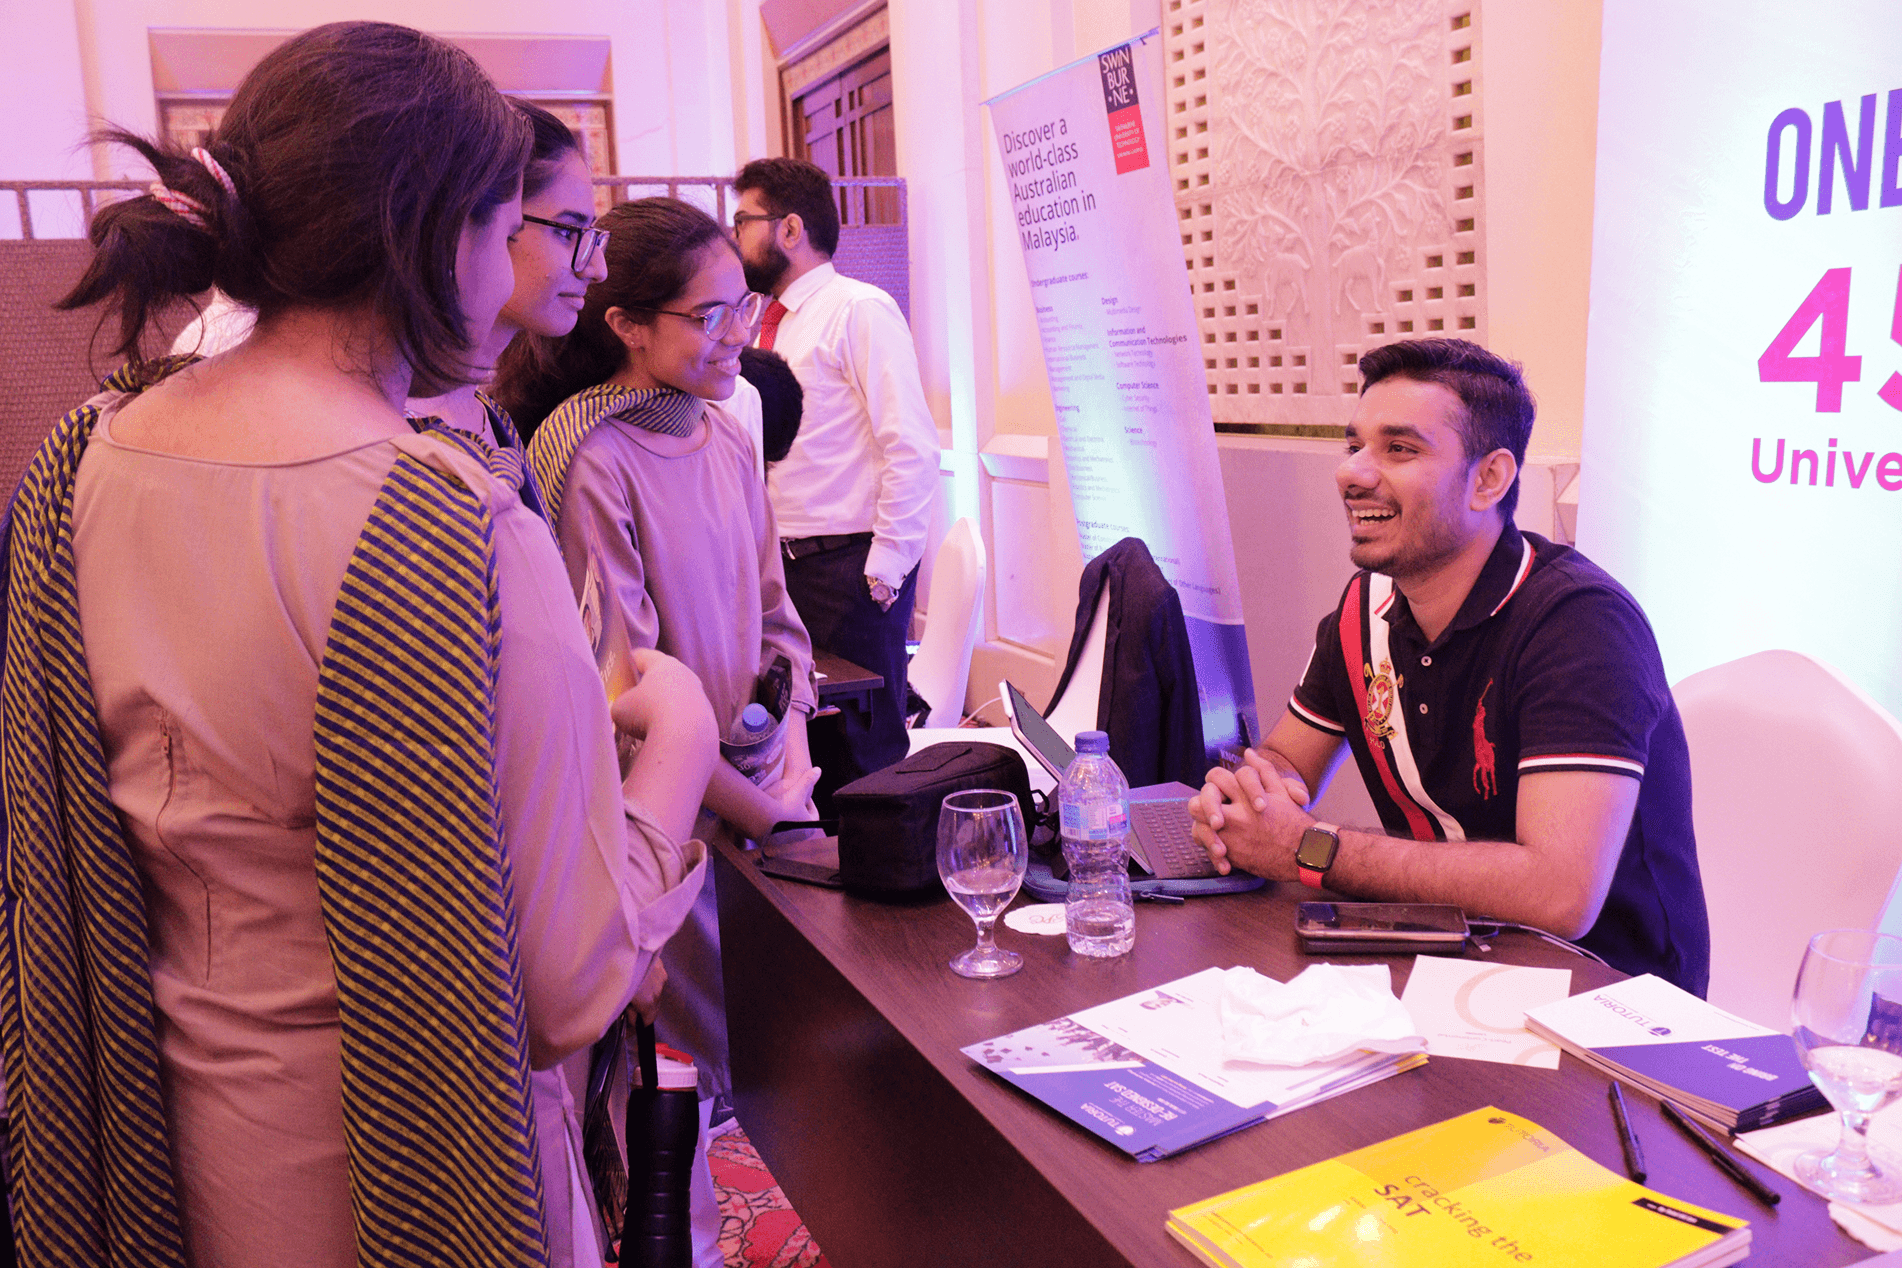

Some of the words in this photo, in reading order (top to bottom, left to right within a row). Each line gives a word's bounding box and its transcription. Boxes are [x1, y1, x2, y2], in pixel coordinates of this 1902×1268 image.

[1101, 48, 1130, 73] SWIN
[1107, 67, 1128, 90] BUR
[1003, 121, 1055, 154] Discover
[1059, 117, 1068, 136] a
[1008, 142, 1079, 179] world-class
[1014, 170, 1077, 202] Australian
[1018, 195, 1080, 227] education
[1082, 190, 1097, 210] in
[1107, 328, 1136, 336] Information
[1109, 338, 1147, 348] Communication
[1147, 334, 1188, 346] Technologies
[1758, 264, 1902, 413] 4
[1752, 437, 1902, 491] Unive
[1593, 994, 1650, 1028] TUTORIA
[1374, 1184, 1432, 1217] SAT
[1404, 1175, 1493, 1238] cracking
[1491, 1236, 1533, 1263] the
